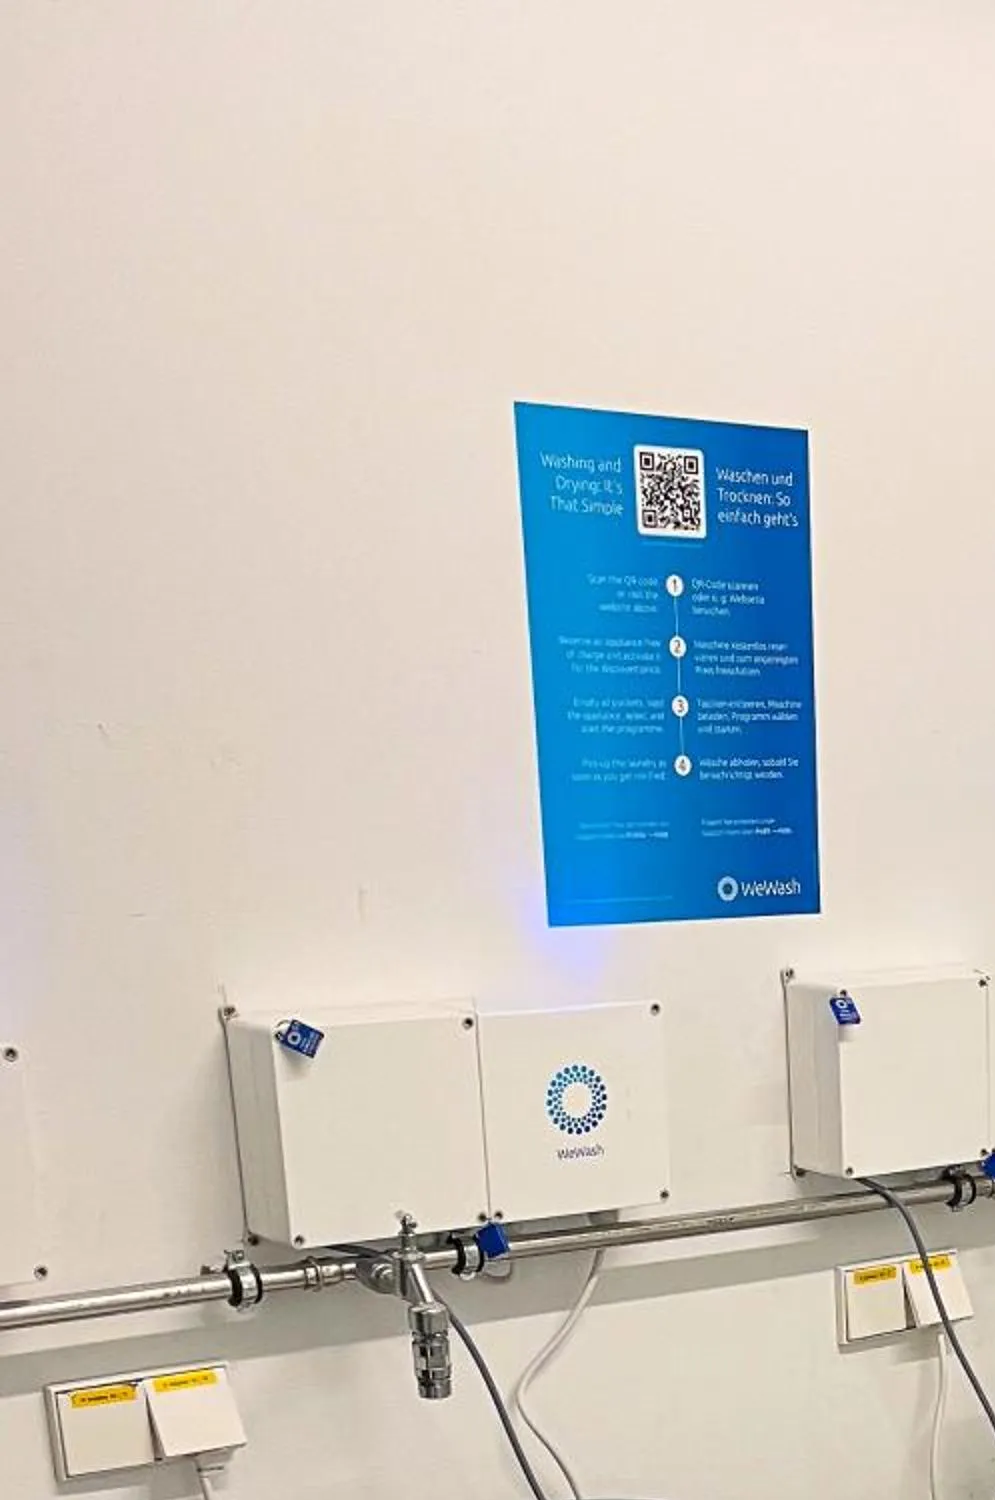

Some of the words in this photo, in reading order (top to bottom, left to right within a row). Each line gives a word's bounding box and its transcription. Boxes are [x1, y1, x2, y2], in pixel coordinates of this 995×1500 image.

[539, 450, 595, 474] Washing
[598, 456, 621, 472] and
[555, 475, 602, 495] Drying:
[603, 479, 623, 495] It's
[715, 466, 769, 485] Waschen
[771, 472, 793, 487] und
[551, 495, 579, 513] That
[581, 498, 624, 516] Simple
[715, 487, 774, 506] Trocknen:
[776, 491, 791, 507] So
[717, 507, 761, 525] einfach
[763, 511, 799, 529] geht's
[741, 877, 801, 897] WeWash
[556, 1143, 605, 1161] WeWash
